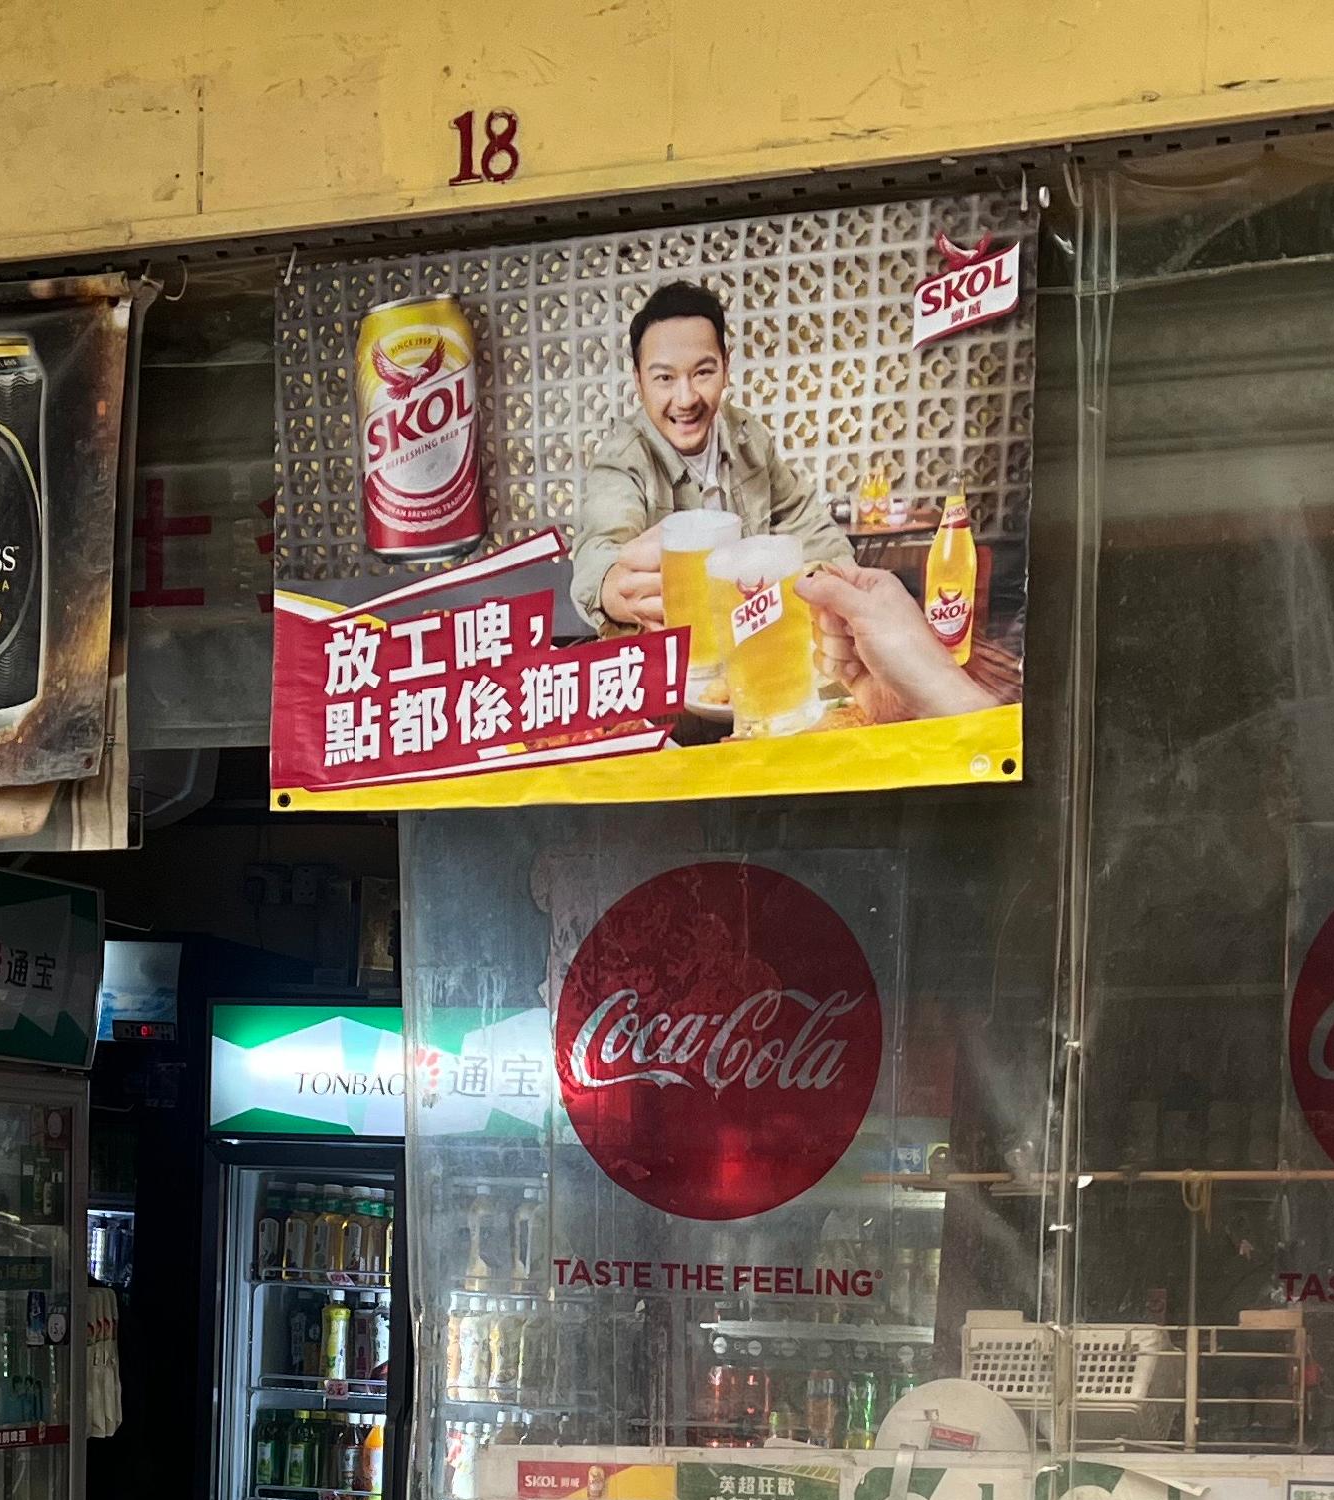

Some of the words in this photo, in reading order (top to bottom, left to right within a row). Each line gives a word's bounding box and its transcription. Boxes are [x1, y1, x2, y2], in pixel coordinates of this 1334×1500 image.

[448, 110, 520, 186] 18
[918, 256, 1012, 318] SKOL
[368, 377, 473, 463] SKOL
[439, 428, 460, 444] BEER
[733, 589, 779, 629] SKOL
[929, 601, 969, 623] SKOL
[3, 947, 57, 992] 通宝
[569, 987, 866, 1090] Coca-Cola
[447, 1053, 544, 1099] 通宝
[553, 1258, 652, 1289] TASTE
[659, 1262, 725, 1292] THE
[732, 1265, 875, 1298] FEELING
[524, 1474, 558, 1489] SKOL
[718, 1474, 796, 1497] 英超狂歡
